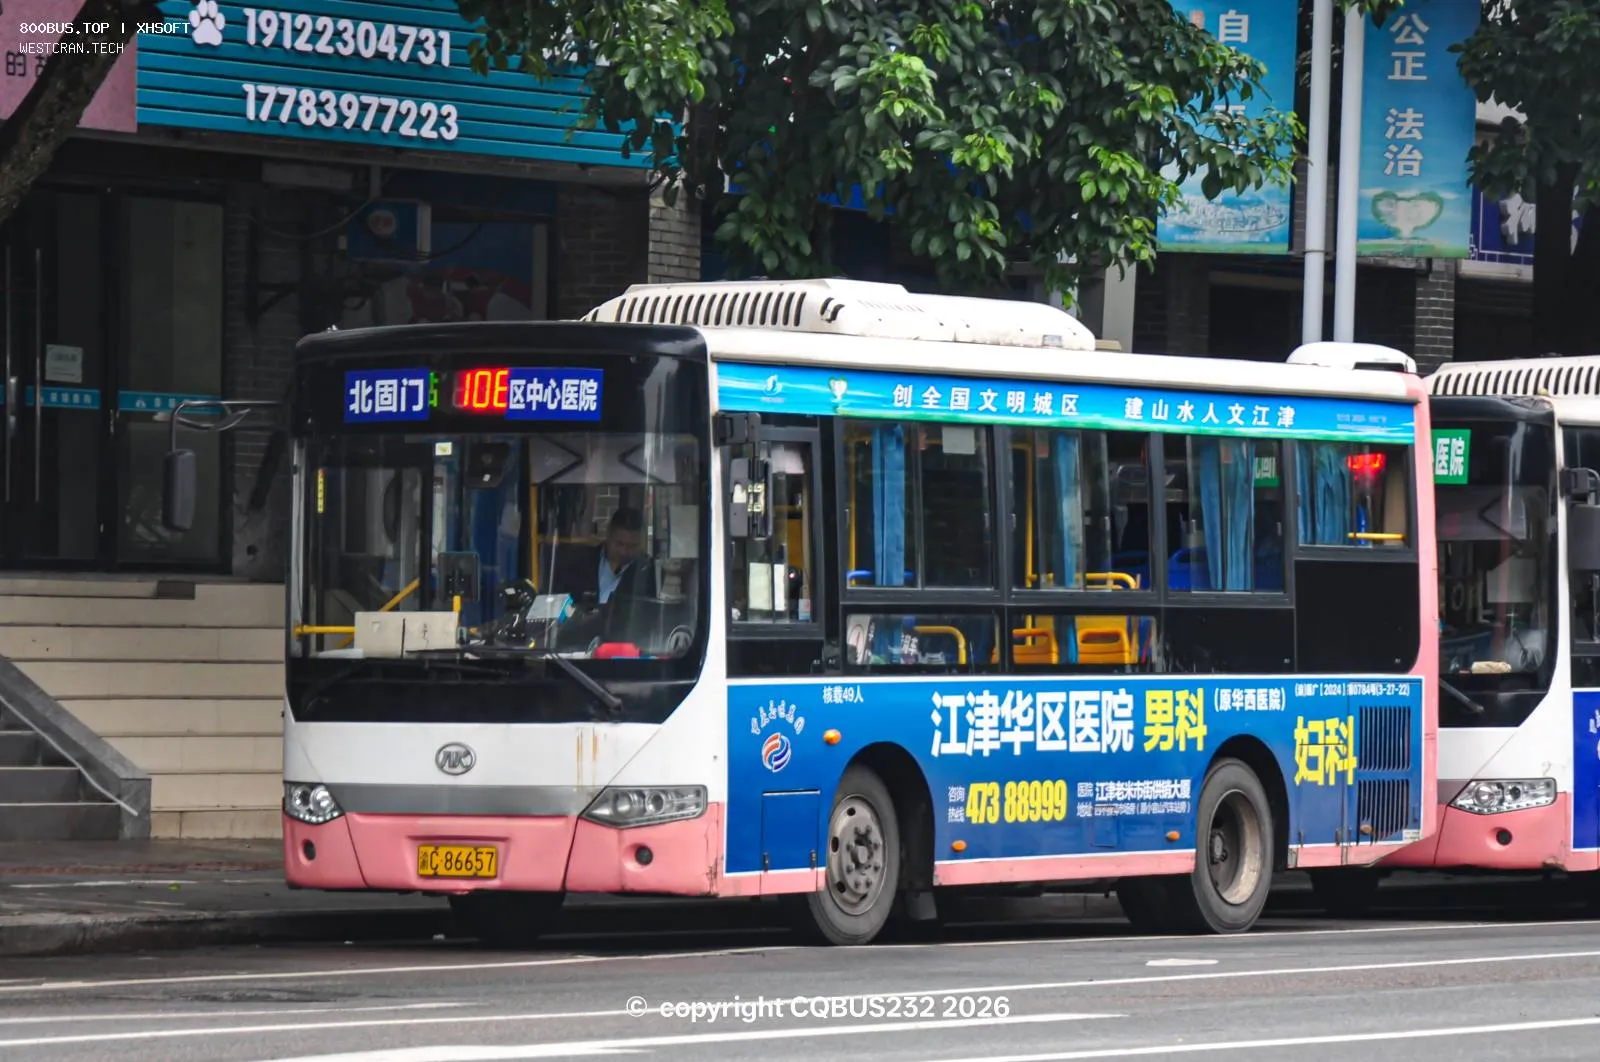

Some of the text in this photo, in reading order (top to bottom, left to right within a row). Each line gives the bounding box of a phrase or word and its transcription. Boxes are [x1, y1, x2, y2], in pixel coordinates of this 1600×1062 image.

[243, 8, 451, 67] 19122304731
[242, 83, 459, 140] 17783977223
[1384, 12, 1430, 177] 公正 法治
[349, 377, 424, 414] 北固门
[509, 378, 598, 411] 区中心医院
[892, 384, 1296, 428] 创全国文明城区 建山水人文江津
[1435, 436, 1465, 476] 医院
[822, 685, 864, 704] 核载49人
[930, 688, 1134, 757] 江津华区医院
[1143, 687, 1207, 752] 男科
[1294, 715, 1357, 786] 妇科
[966, 781, 1000, 824] 473
[1004, 779, 1068, 823] 88999
